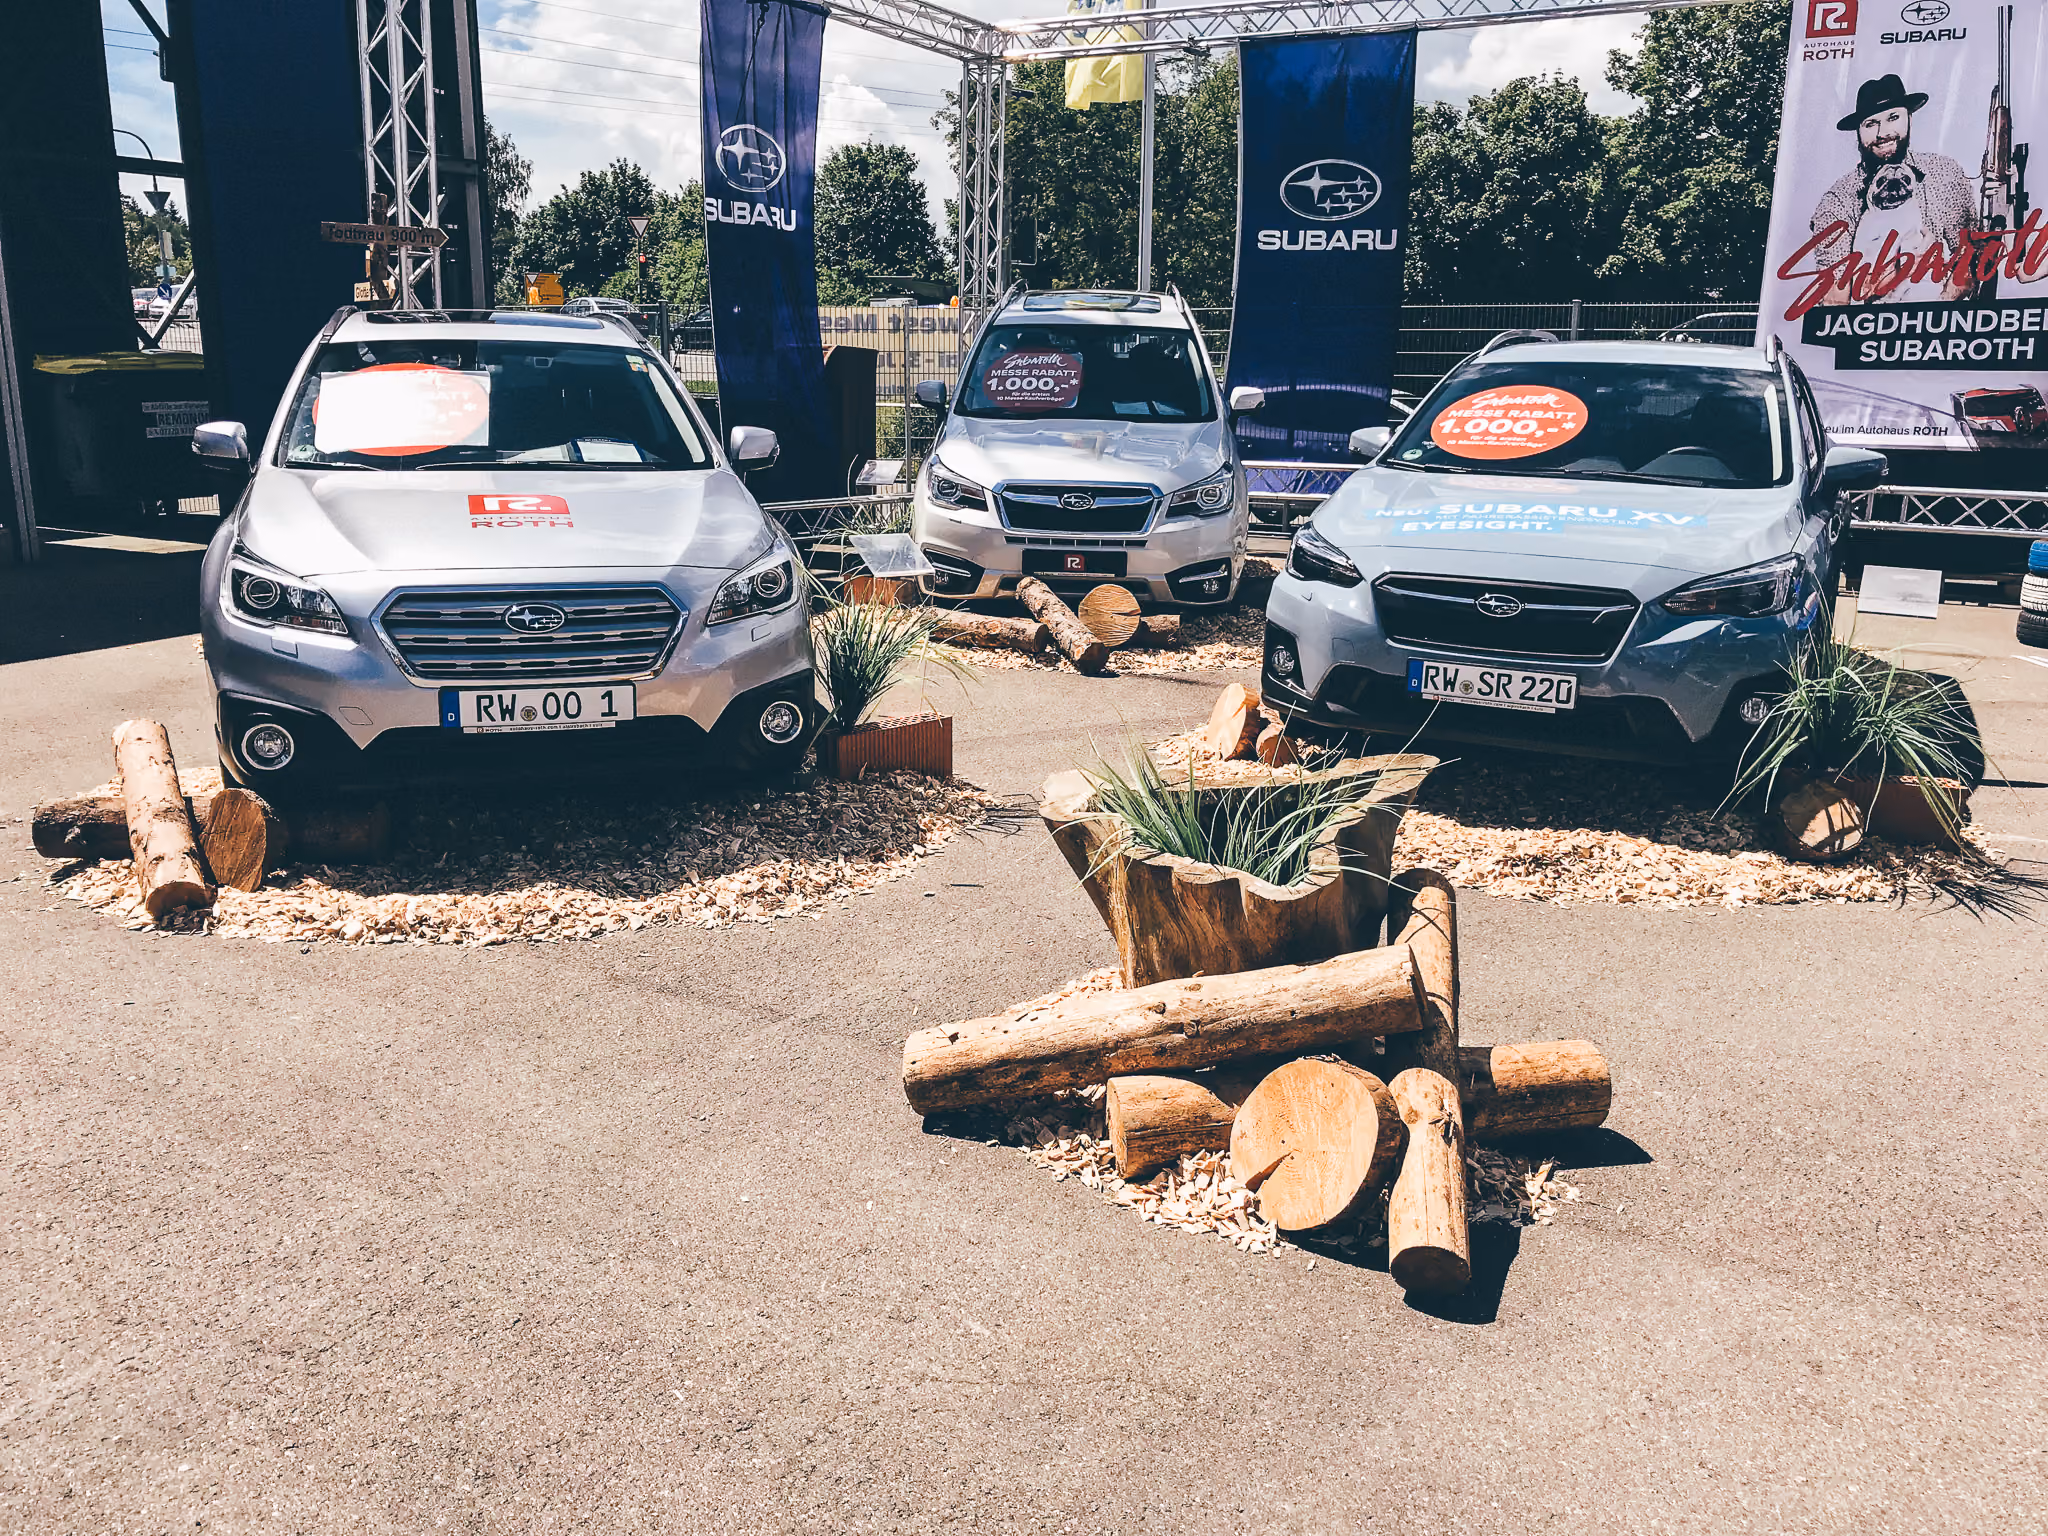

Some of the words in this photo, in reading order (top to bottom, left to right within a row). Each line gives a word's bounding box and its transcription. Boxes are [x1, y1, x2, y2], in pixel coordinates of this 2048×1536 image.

[1879, 28, 1967, 45] SUBARU
[1803, 40, 1855, 49] AUTOHAUS
[1802, 48, 1855, 62] ROTH
[704, 197, 797, 231] SUBARU
[391, 228, 417, 242] 900
[1257, 229, 1398, 251] SUBARU
[1859, 337, 2036, 363] SUBAROTH
[991, 369, 1029, 377] MESSE
[1447, 409, 1505, 418] MESSE
[1507, 410, 1577, 420] RABATT
[1823, 426, 1839, 434] eu
[1841, 424, 1855, 434] im
[1857, 425, 1910, 435] Autohaus
[1913, 426, 1949, 436] ROTH
[1437, 503, 1618, 518] SUBARU
[1630, 509, 1695, 525] XV
[471, 520, 574, 528] ROTH
[1402, 520, 1553, 532] EYESIGHT.
[1423, 665, 1460, 693] RW
[1477, 671, 1513, 699] SR
[1518, 676, 1573, 705] 220
[475, 693, 517, 722] RW
[600, 689, 619, 718] 1
